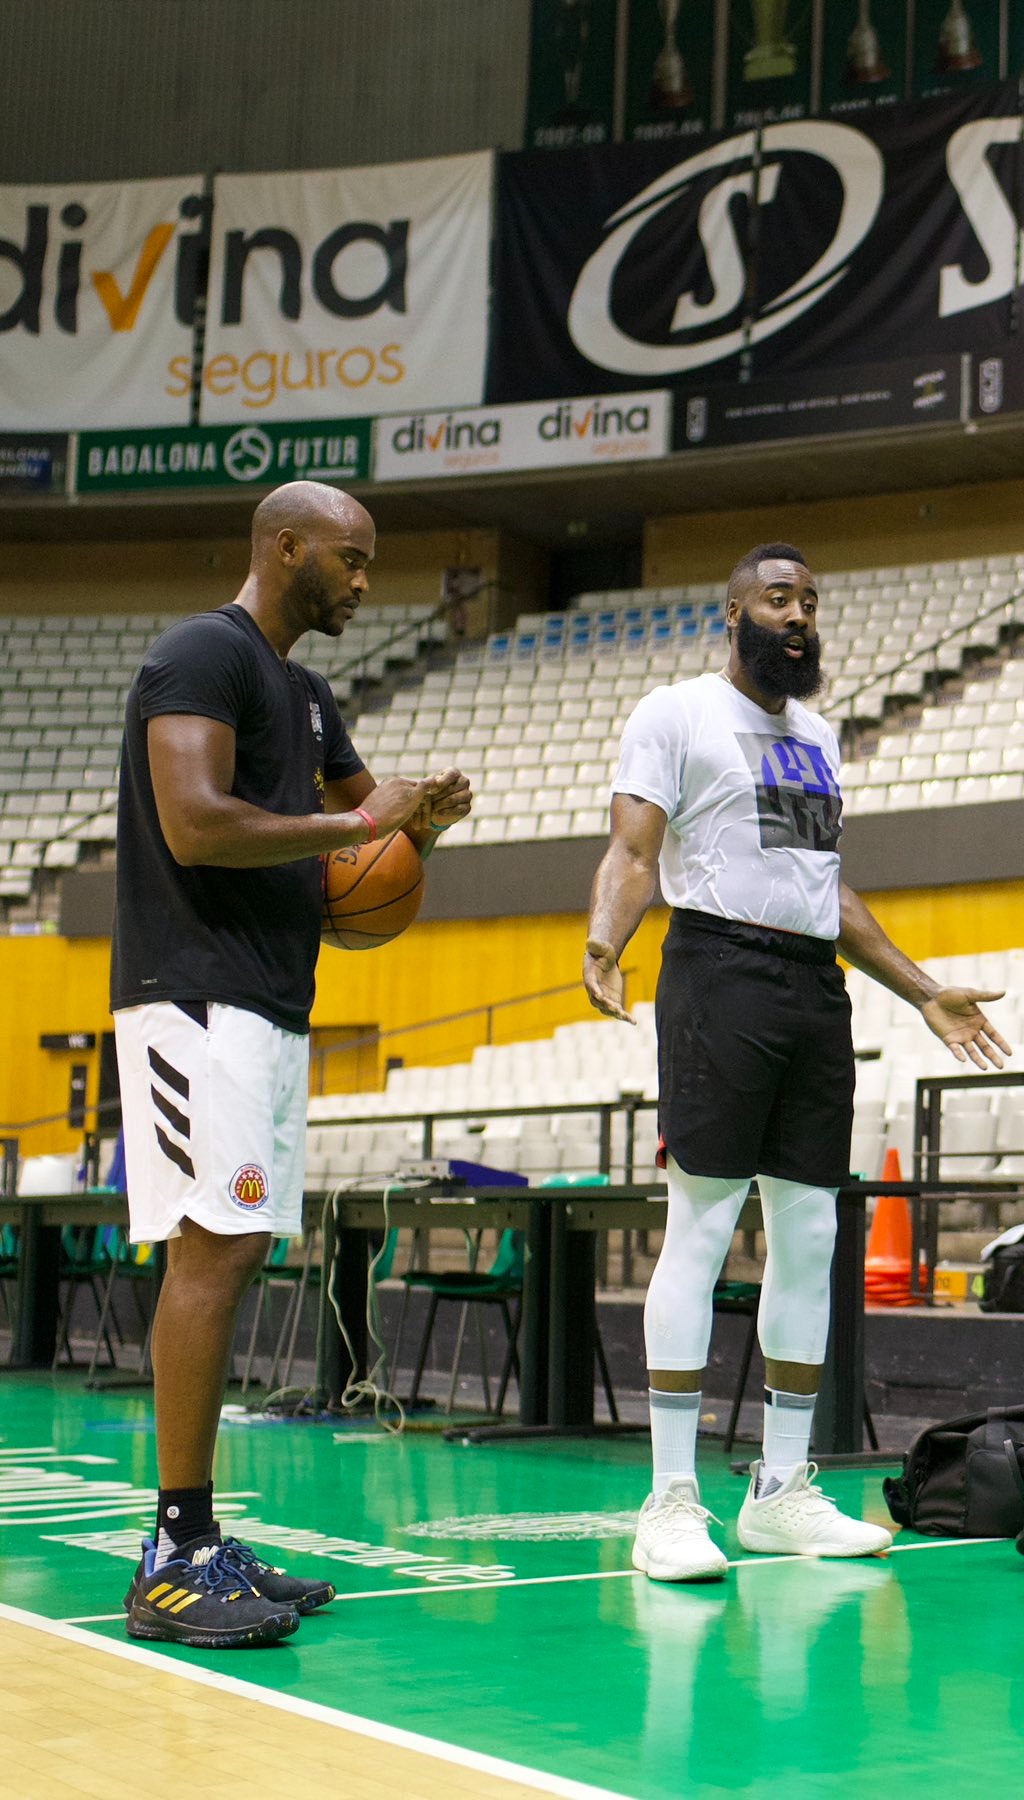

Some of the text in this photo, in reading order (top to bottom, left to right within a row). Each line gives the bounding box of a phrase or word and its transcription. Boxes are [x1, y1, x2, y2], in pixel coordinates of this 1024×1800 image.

[0, 195, 411, 337] divina
[165, 344, 406, 408] seguros
[391, 416, 500, 454] divina
[537, 402, 650, 441] divina
[88, 435, 359, 477] BADALONA FUTUR
